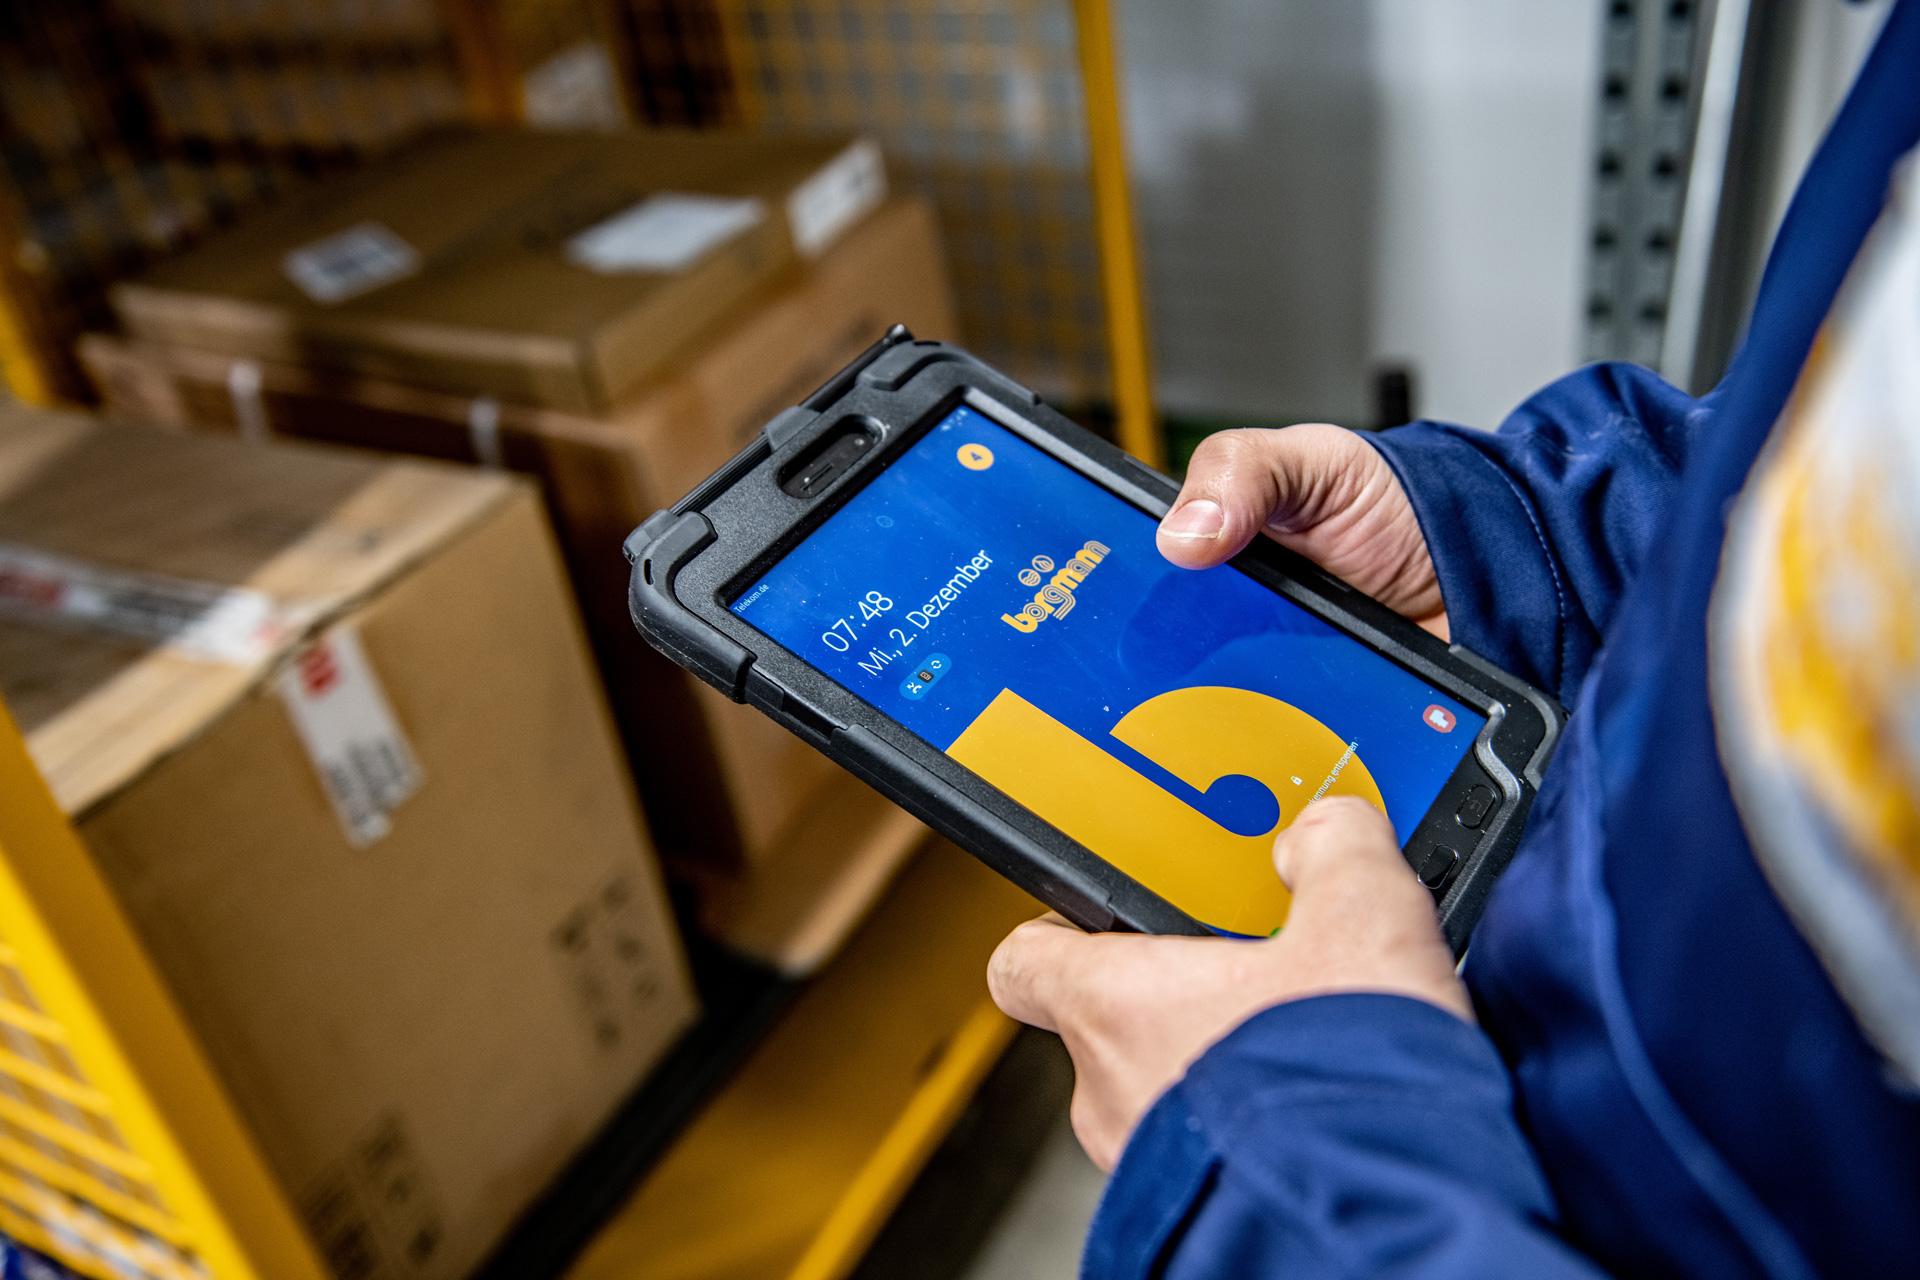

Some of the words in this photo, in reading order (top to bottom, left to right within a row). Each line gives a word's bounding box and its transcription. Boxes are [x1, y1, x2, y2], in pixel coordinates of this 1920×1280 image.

[733, 584, 770, 613] Telekom.de
[857, 647, 903, 676] Mi.,
[889, 628, 918, 647] 2.
[905, 549, 994, 630] Dezember
[1001, 540, 1111, 633] borgmann
[822, 590, 893, 652] 07:48
[1330, 741, 1359, 777] entsperren
